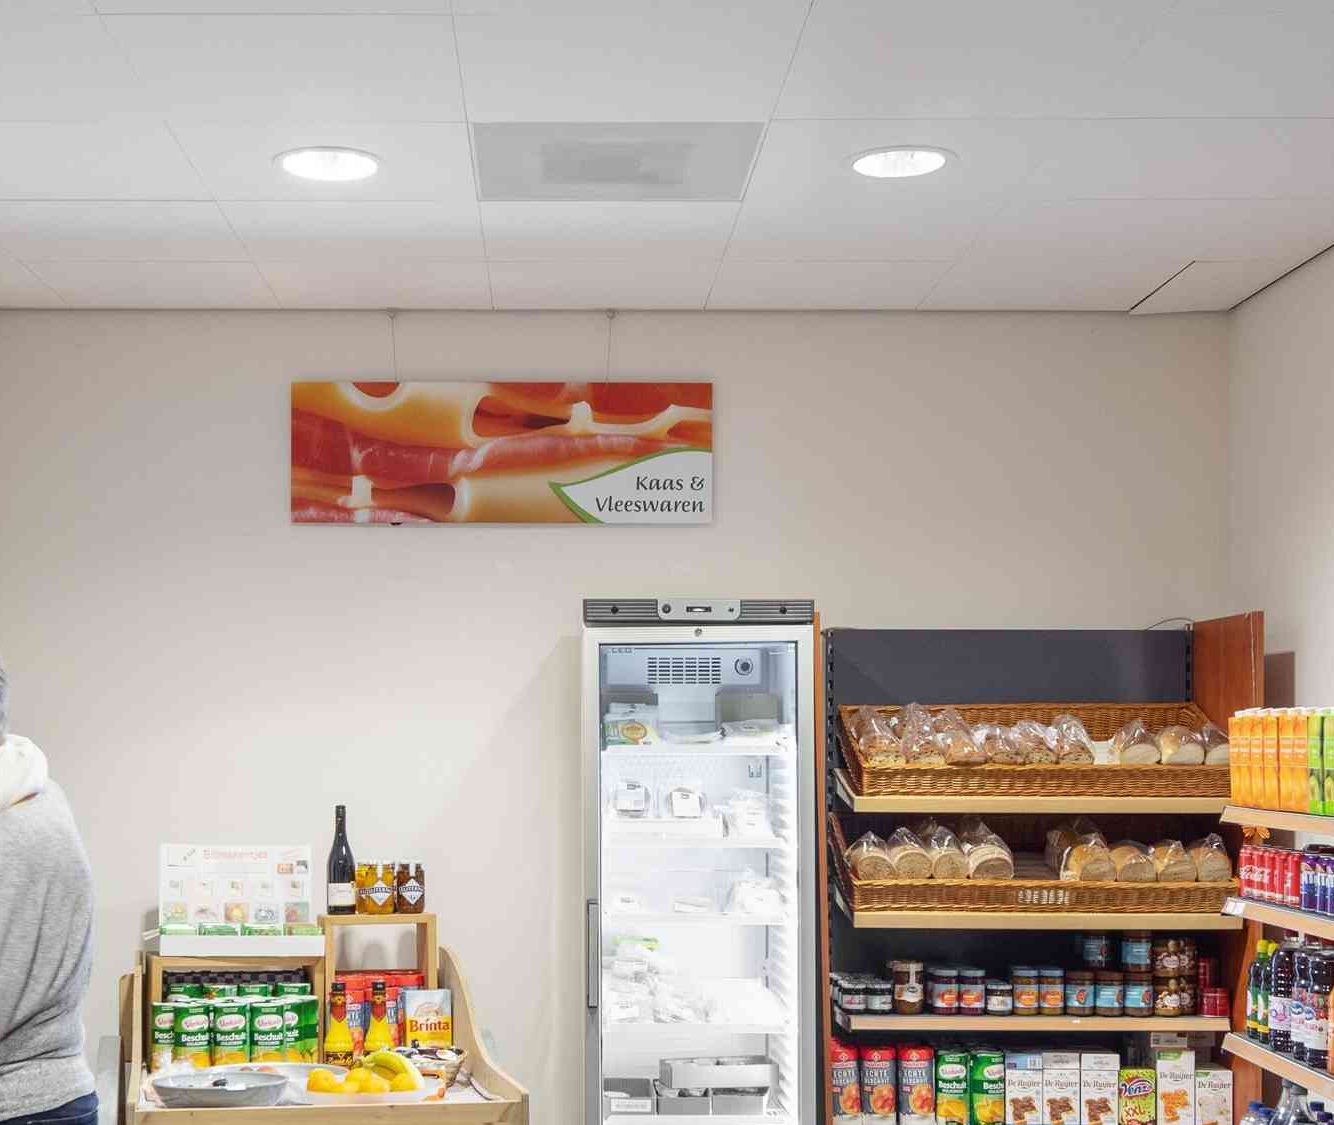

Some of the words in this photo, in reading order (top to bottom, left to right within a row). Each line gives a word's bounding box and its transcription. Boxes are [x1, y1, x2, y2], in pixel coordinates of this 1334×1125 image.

[635, 475, 684, 491] Kaas
[690, 475, 705, 491] &
[595, 495, 706, 513] Vleeswaren
[409, 1017, 450, 1032] Brinta
